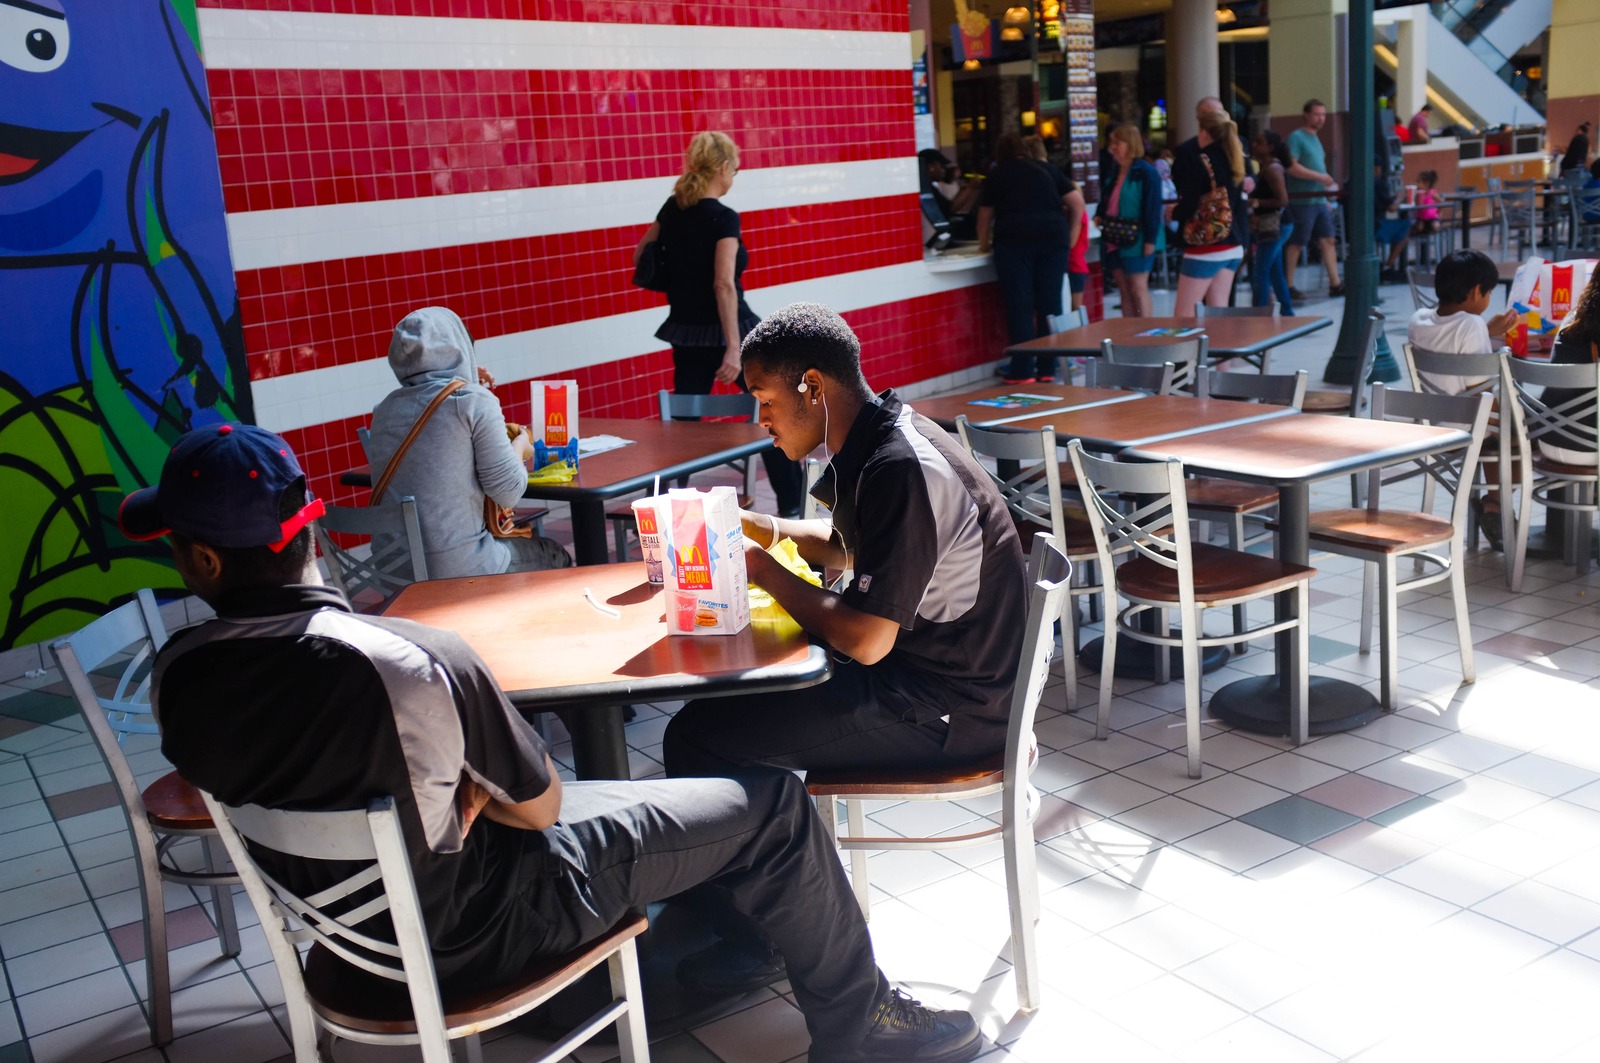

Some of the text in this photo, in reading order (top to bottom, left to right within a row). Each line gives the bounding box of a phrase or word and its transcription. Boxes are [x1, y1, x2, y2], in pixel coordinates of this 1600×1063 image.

[647, 535, 660, 544] TALL
[685, 571, 710, 584] MEDAL
[698, 599, 729, 609] FAVORITES
